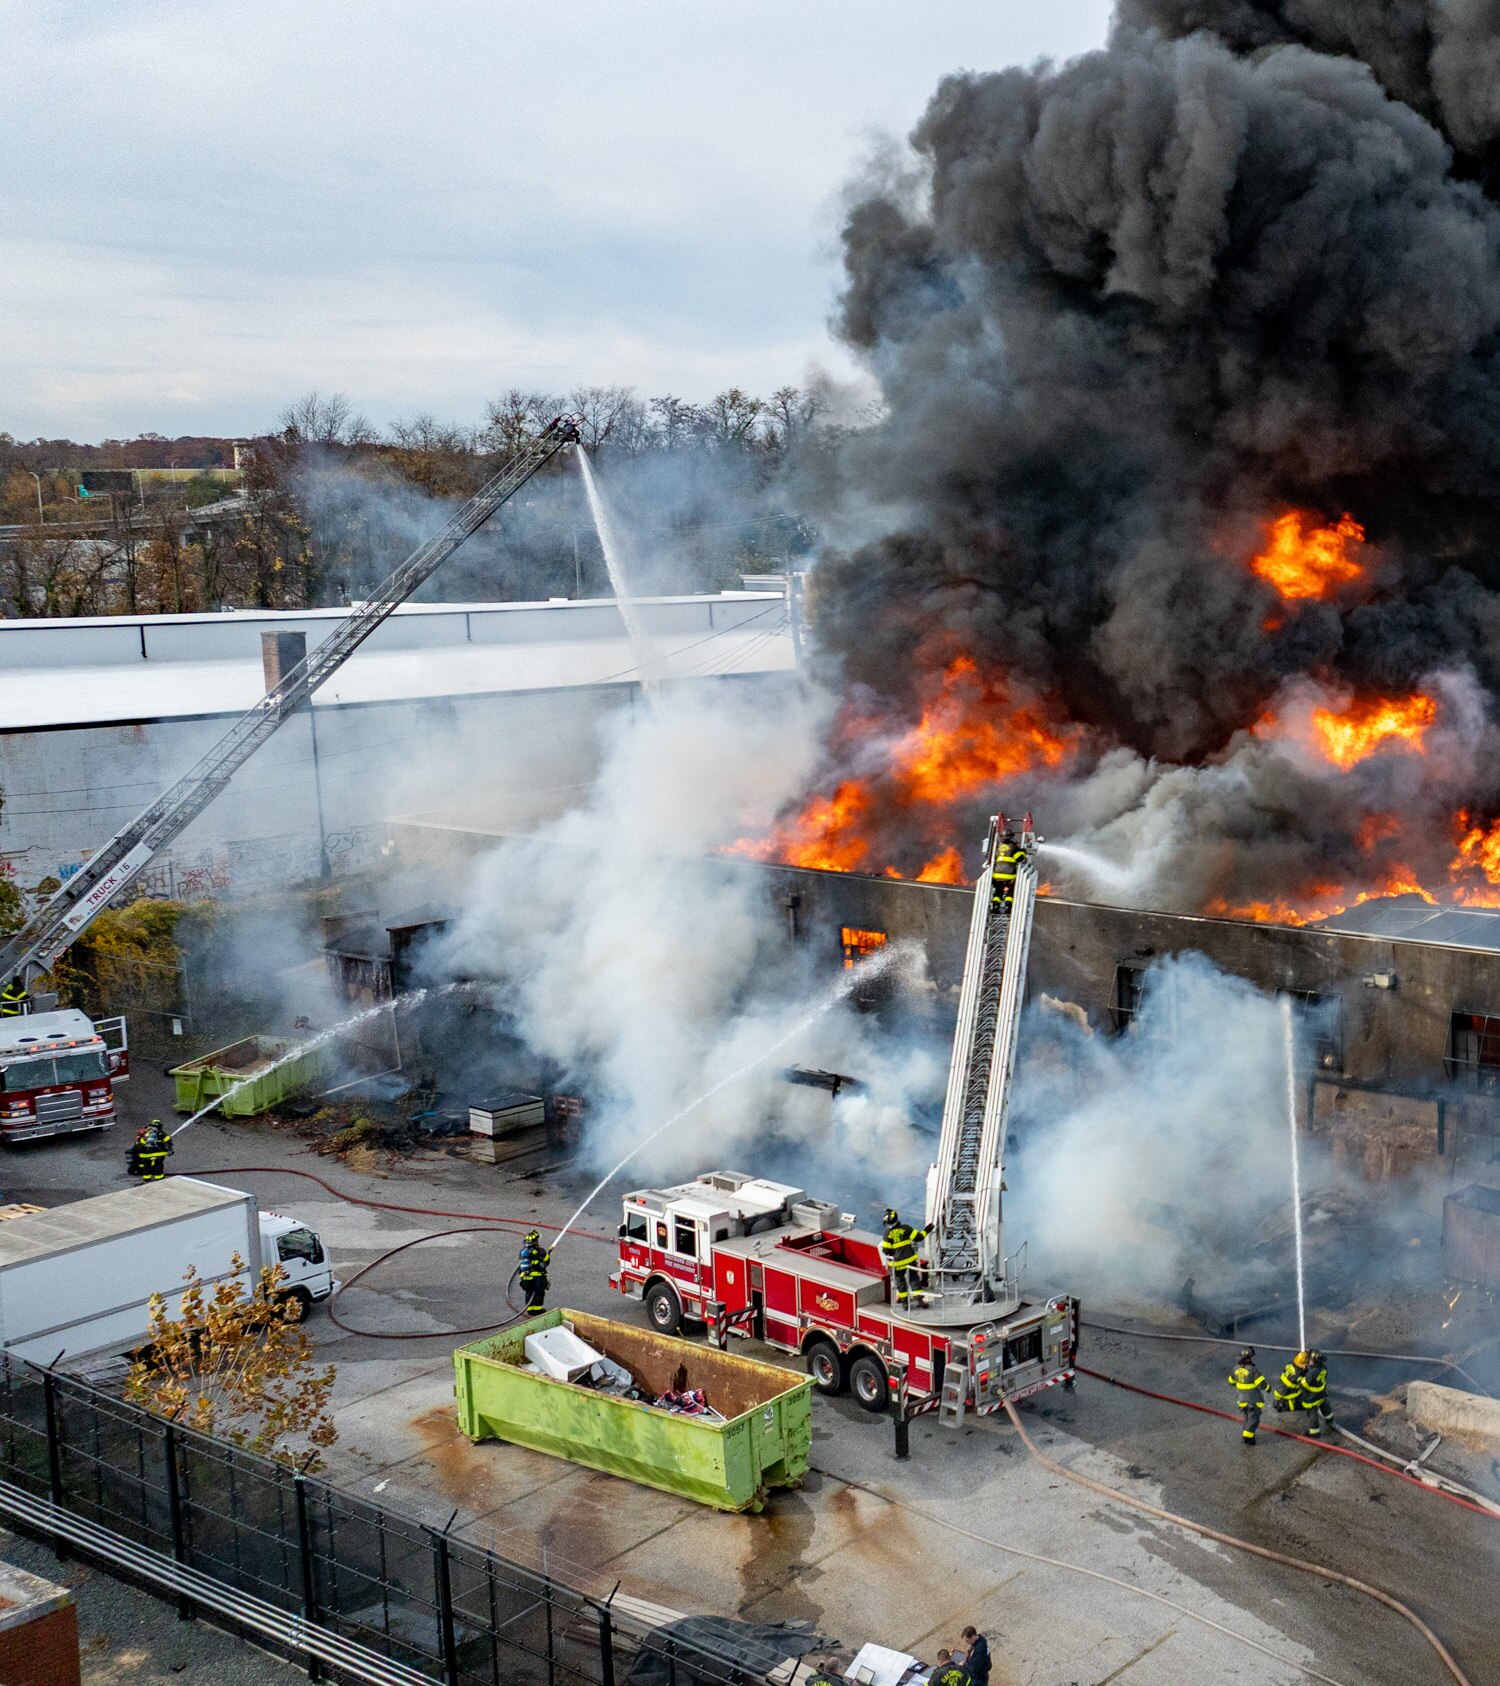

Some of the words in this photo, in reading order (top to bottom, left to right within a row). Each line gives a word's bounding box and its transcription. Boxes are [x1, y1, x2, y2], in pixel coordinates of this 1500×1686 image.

[87, 876, 117, 905] TRUCK
[119, 863, 130, 873] 16
[788, 1390, 806, 1406] 3057
[726, 1423, 745, 1440] 3057
